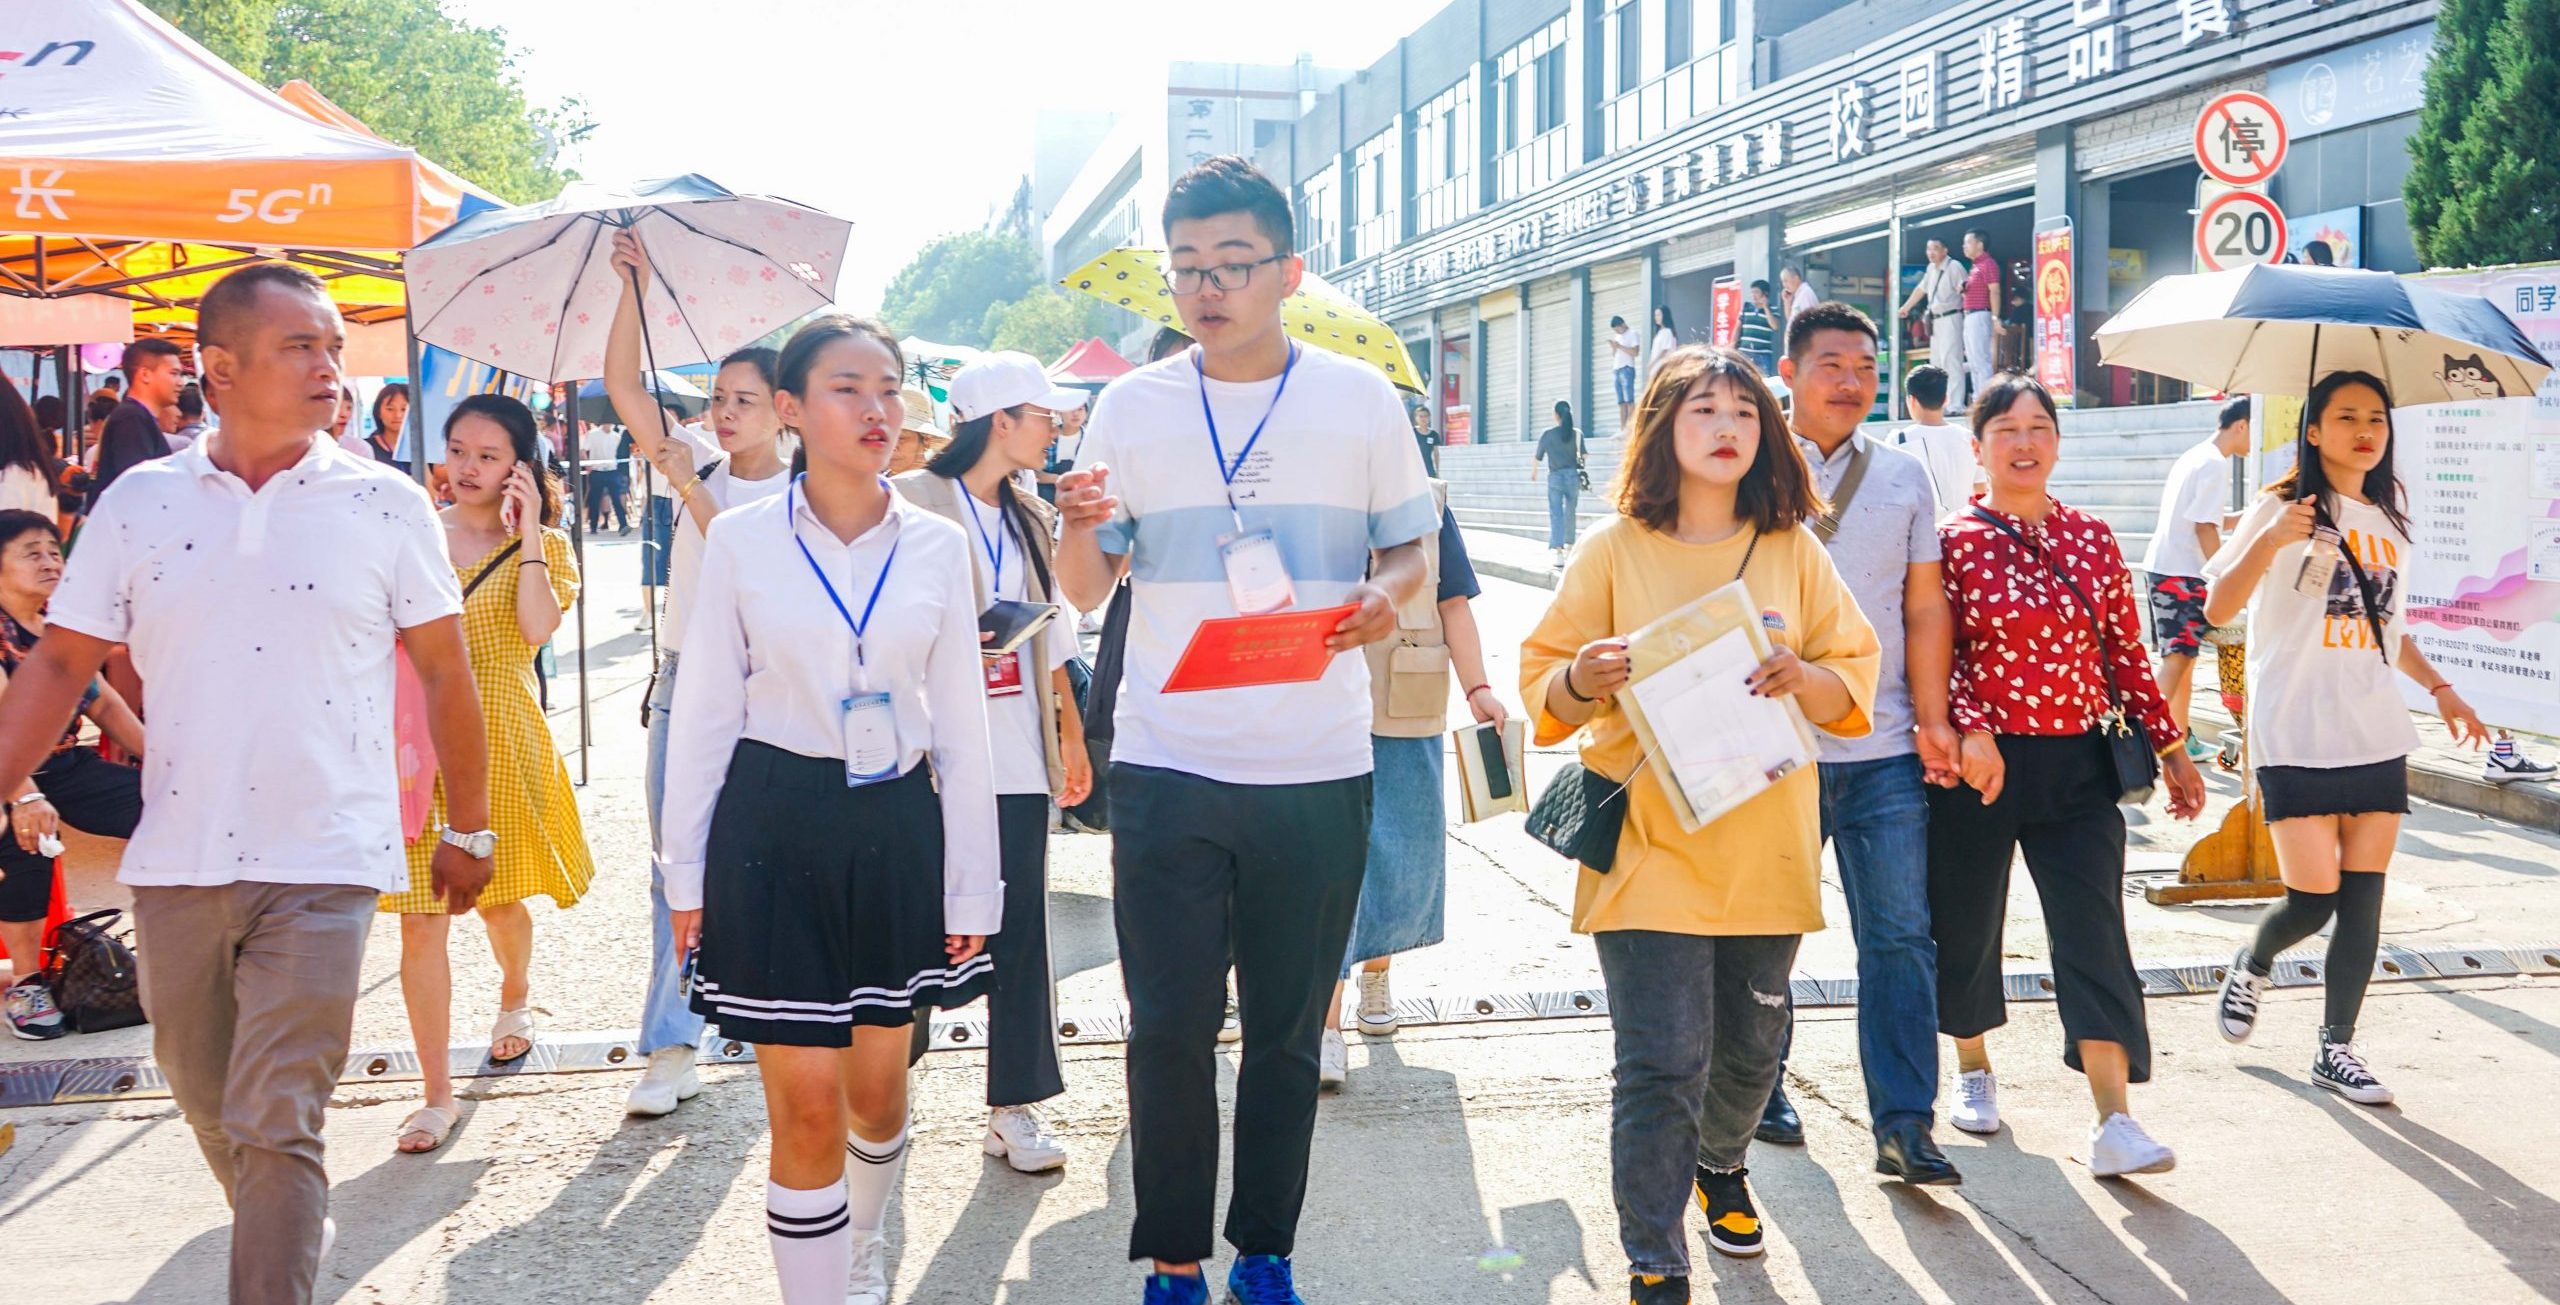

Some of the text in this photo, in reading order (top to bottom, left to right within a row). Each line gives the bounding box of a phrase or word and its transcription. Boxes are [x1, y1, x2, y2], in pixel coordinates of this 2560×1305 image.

[2219, 118, 2266, 165] 停
[2213, 212, 2272, 256] 20
[2515, 285, 2560, 313] 同学
